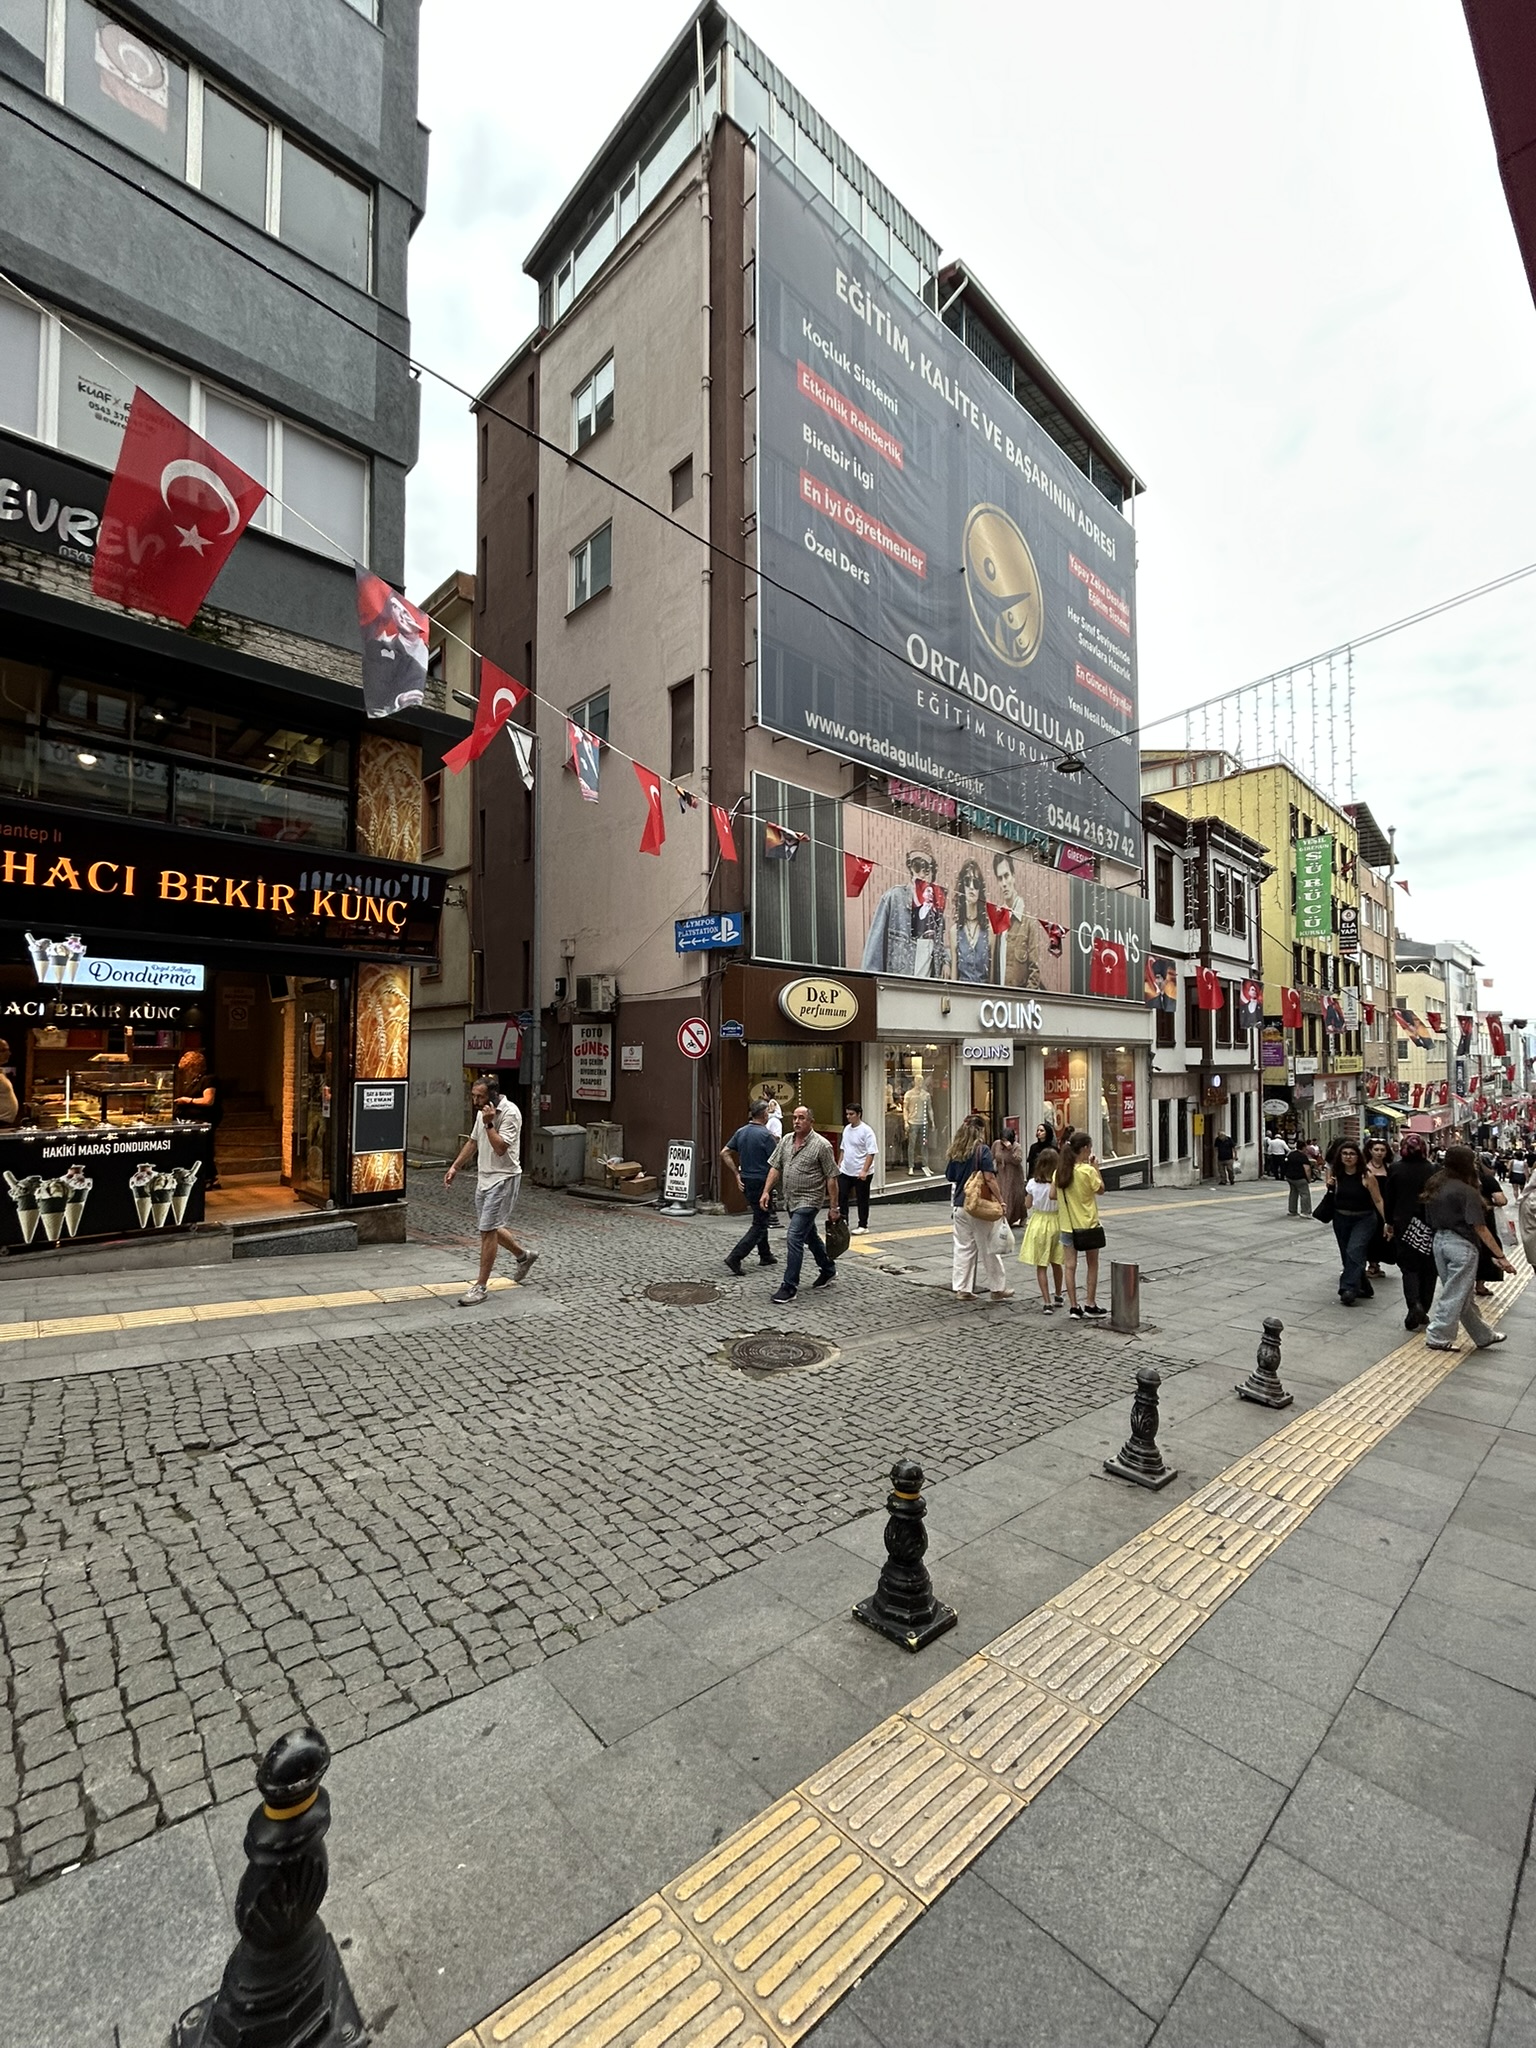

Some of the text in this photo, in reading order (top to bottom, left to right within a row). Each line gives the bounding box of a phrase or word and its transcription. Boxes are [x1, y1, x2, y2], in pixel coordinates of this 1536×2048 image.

[803, 318, 898, 415] Koçluk Sistemi
[803, 372, 901, 462] Etkinlik Rehberlik
[836, 267, 1115, 561] EĞİTİM, KALİTE VE BAŞARININ ADRESİ
[803, 423, 874, 489] Birebir İlgi
[803, 477, 924, 570] En İyi Öğretmenler
[804, 528, 871, 585] Özel Ders
[1067, 605, 1080, 625] Her
[906, 633, 1087, 758] ORTADOĞULULAR
[1075, 664, 1086, 681] En
[1086, 672, 1108, 697] Güncel
[1067, 695, 1083, 716] Yeni
[1084, 705, 1101, 726] Nesil
[916, 689, 1082, 784] EĞİTİM KURUMLRI
[0, 823, 49, 844] antep
[1048, 803, 1081, 837] 0544
[1083, 818, 1104, 846] 216
[1105, 828, 1119, 851] 37
[1121, 836, 1135, 859] 42
[1, 850, 408, 934] HACI BEKİR KÜNÇ
[88, 960, 197, 987] Dondurma
[0, 1001, 45, 1017] ACI
[806, 986, 841, 1004] D&P
[800, 1004, 847, 1018] perfumum
[980, 999, 1043, 1030] COLIN'S
[581, 1028, 603, 1038] FOTO
[574, 1039, 609, 1060] GÜNEŞ
[963, 1044, 1010, 1060] COLIN'S
[43, 1140, 171, 1158] HAKİKİ MARAŞ DONDURMASI
[669, 1147, 690, 1161] FORMA
